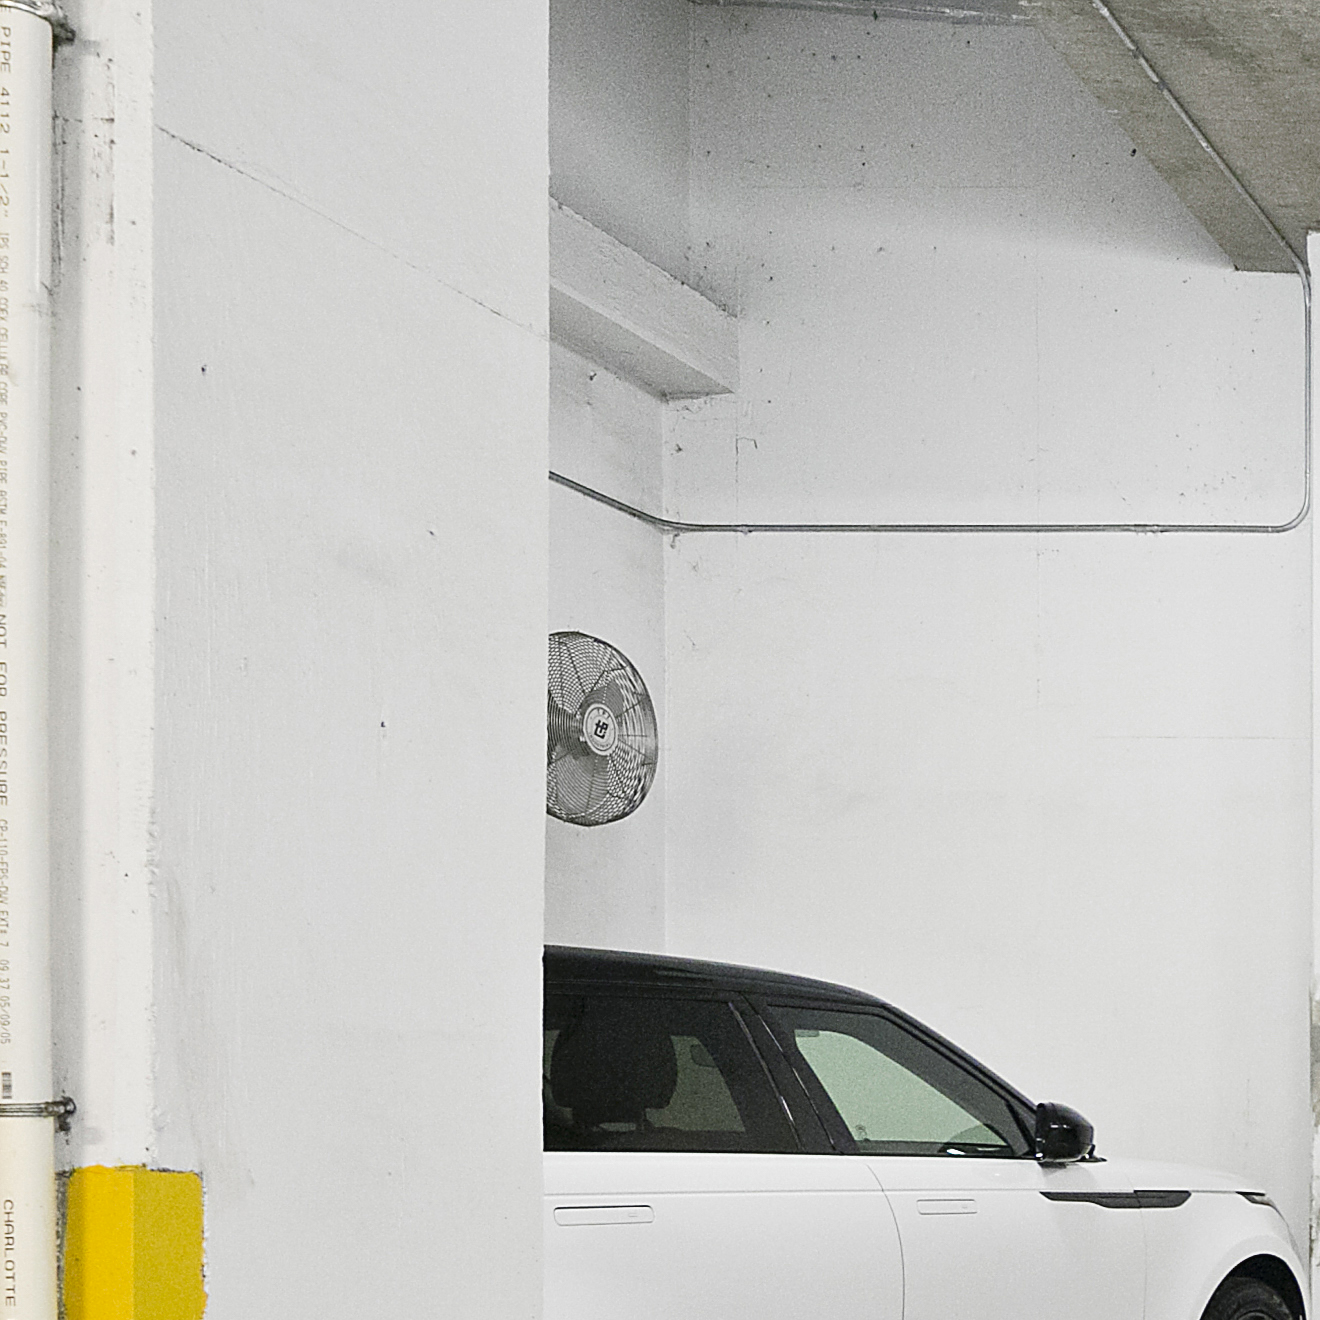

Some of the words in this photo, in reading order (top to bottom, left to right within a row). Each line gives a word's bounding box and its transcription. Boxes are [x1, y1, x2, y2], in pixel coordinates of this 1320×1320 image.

[1, 26, 11, 73] PIPE
[0, 87, 11, 134] 4112
[0, 255, 10, 274] SCH
[0, 280, 9, 292] 40
[0, 614, 8, 649] NOT
[0, 662, 8, 697] FOR
[0, 711, 8, 806] PRESSURE
[3, 1199, 16, 1307] CHARLOTTE
